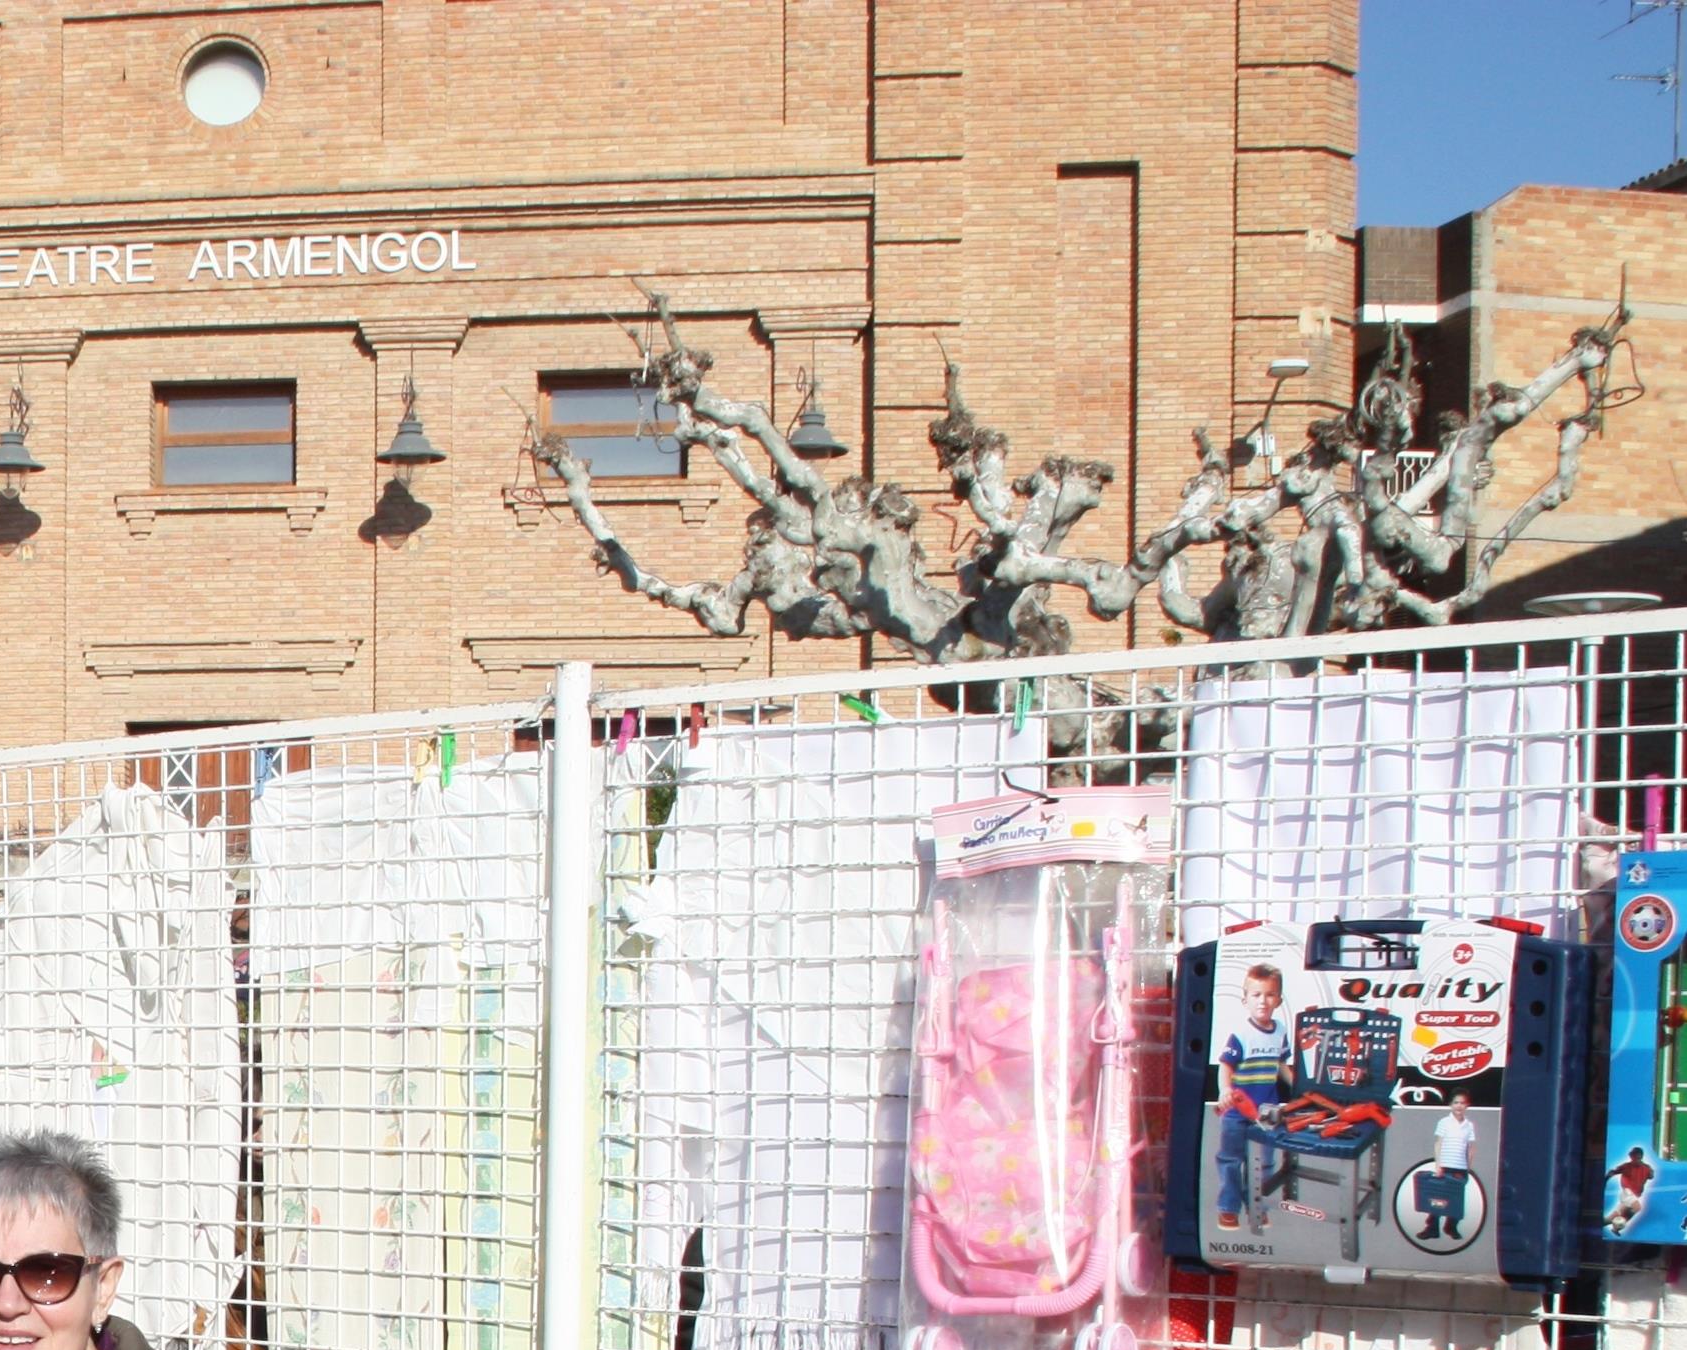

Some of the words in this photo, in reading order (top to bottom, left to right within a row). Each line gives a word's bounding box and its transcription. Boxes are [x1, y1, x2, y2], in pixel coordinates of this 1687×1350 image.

[188, 229, 477, 281] ARMENGOL
[1454, 950, 1473, 961] 3+
[1339, 976, 1505, 1004] Quality
[1419, 1013, 1460, 1024] Super
[1464, 1013, 1496, 1024] Tool
[1423, 1044, 1491, 1064] Portable
[1209, 1242, 1274, 1256] NO.008-21
